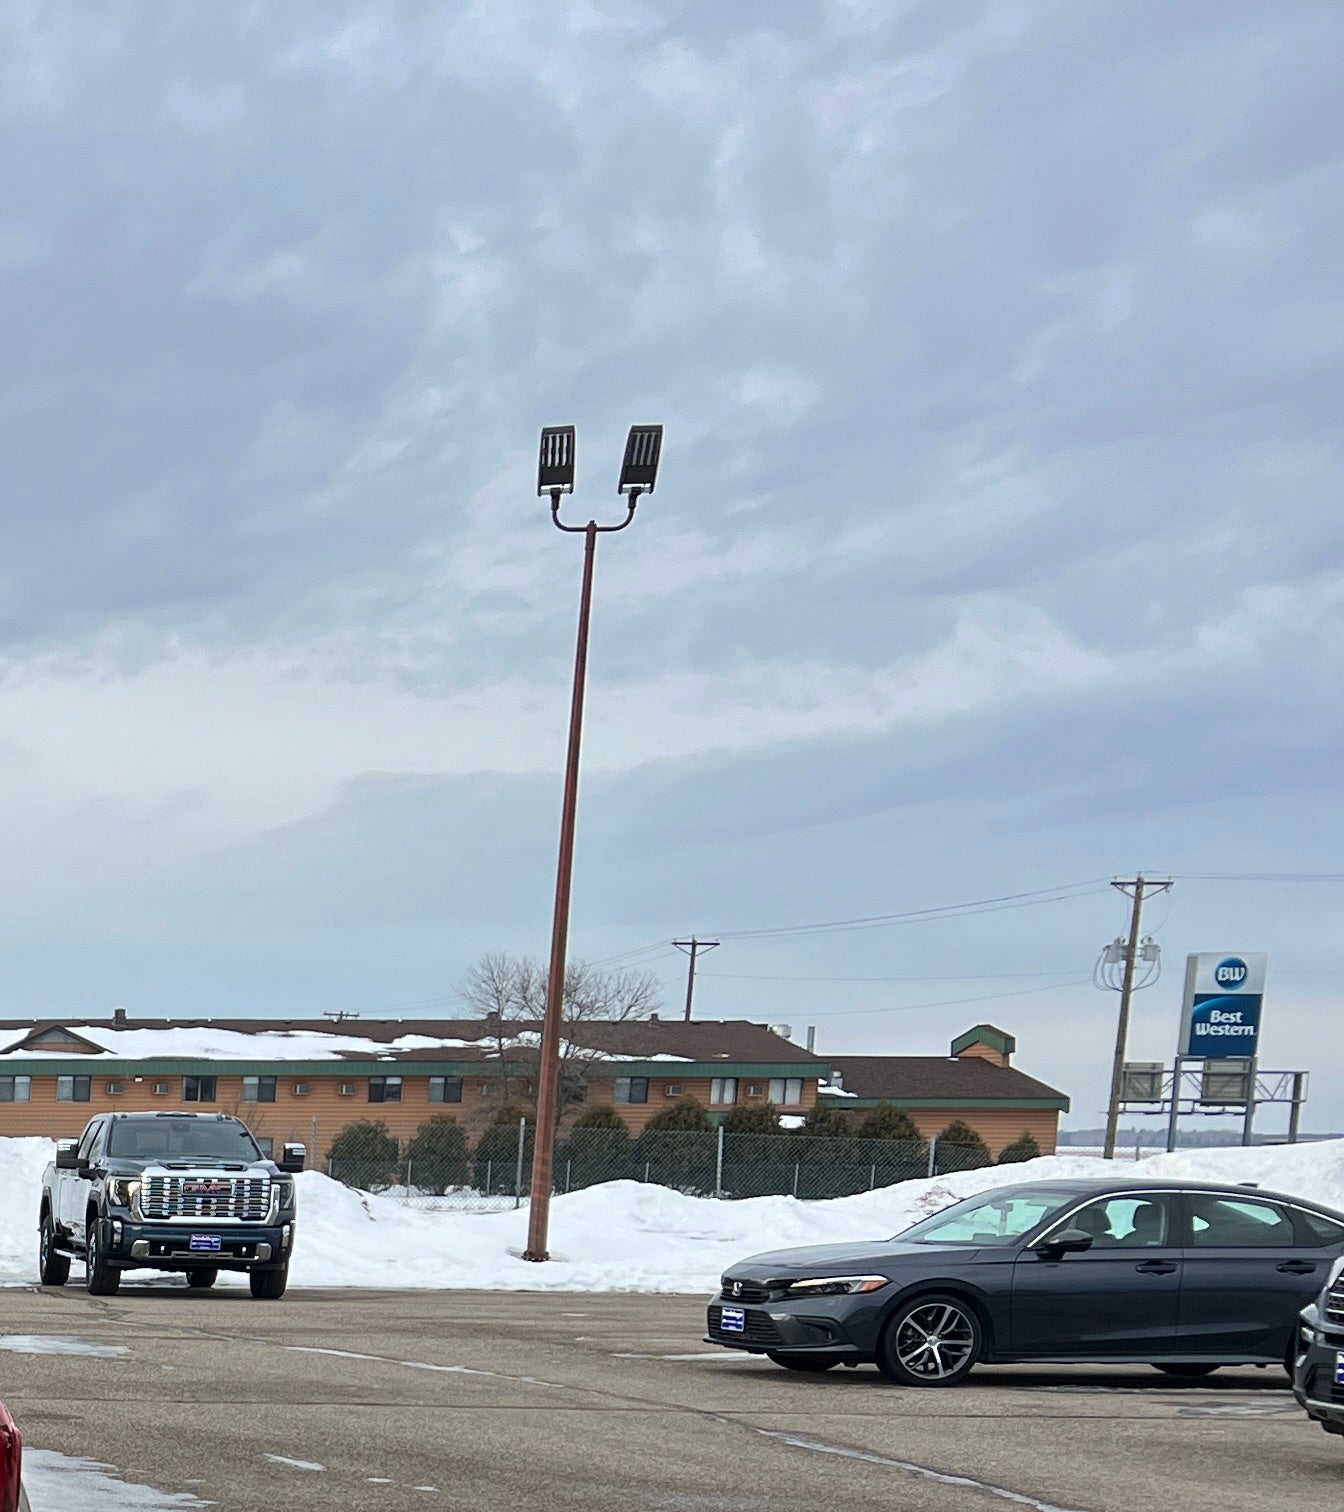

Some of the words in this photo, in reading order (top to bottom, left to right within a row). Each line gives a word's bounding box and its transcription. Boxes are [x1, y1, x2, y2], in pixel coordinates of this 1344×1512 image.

[1217, 967, 1246, 981] BW
[1210, 1010, 1243, 1023] Best
[1195, 1023, 1254, 1036] Western
